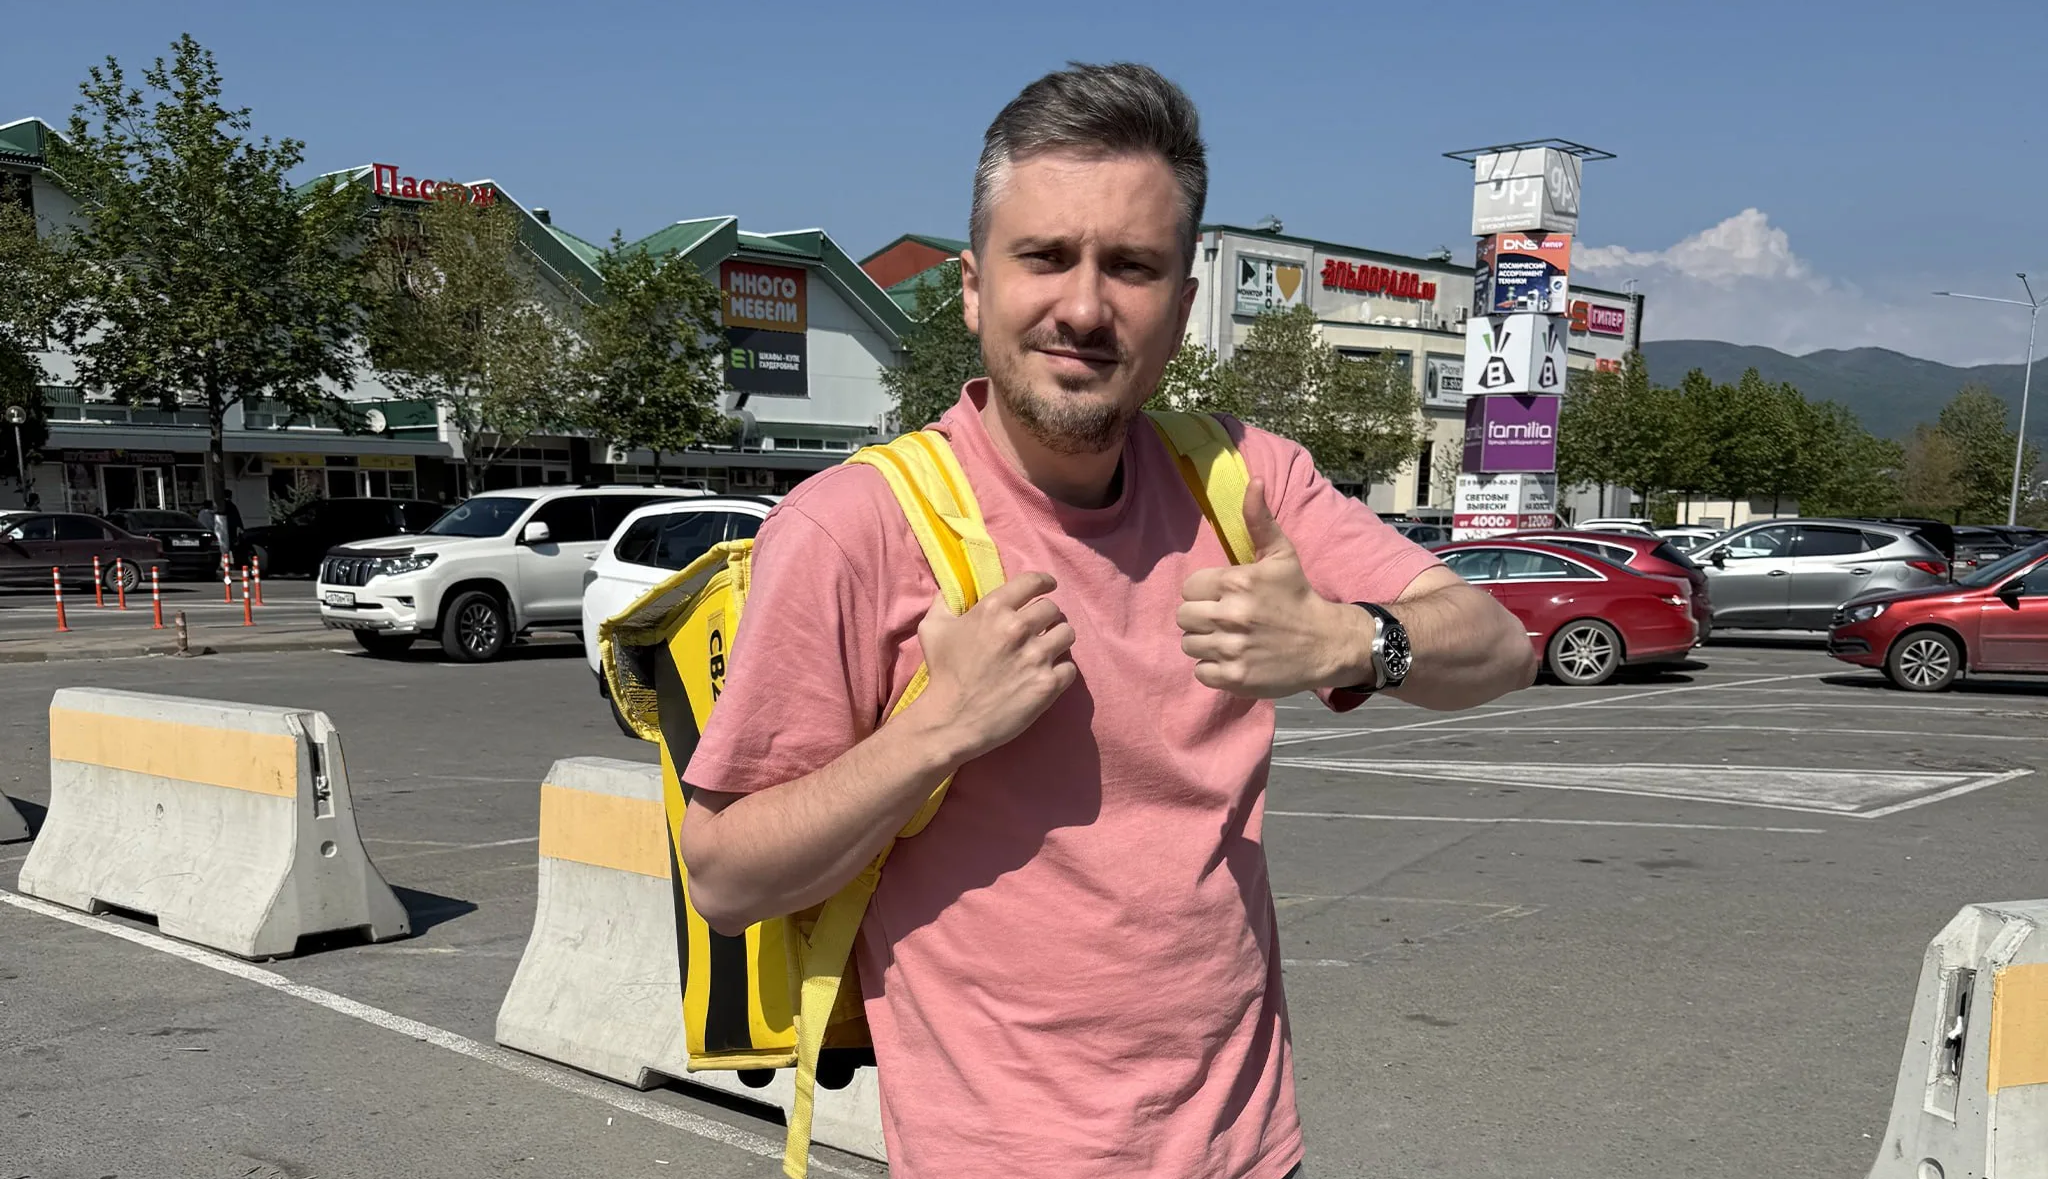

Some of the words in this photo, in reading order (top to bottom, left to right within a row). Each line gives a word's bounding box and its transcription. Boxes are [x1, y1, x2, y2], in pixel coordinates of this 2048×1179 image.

[1503, 239, 1539, 251] DNS
[1498, 261, 1547, 270] КОСМИЧЕСКИЙ
[1498, 270, 1544, 278] АССОРТИМЕНТ
[730, 270, 797, 299] МНОГО
[1265, 259, 1273, 310] КИНО
[731, 296, 798, 323] МЕБЕЛИ
[1592, 309, 1623, 328] ГИПЕР
[1488, 421, 1552, 438] familia
[1465, 494, 1509, 502] СВЕТОВЫЕ
